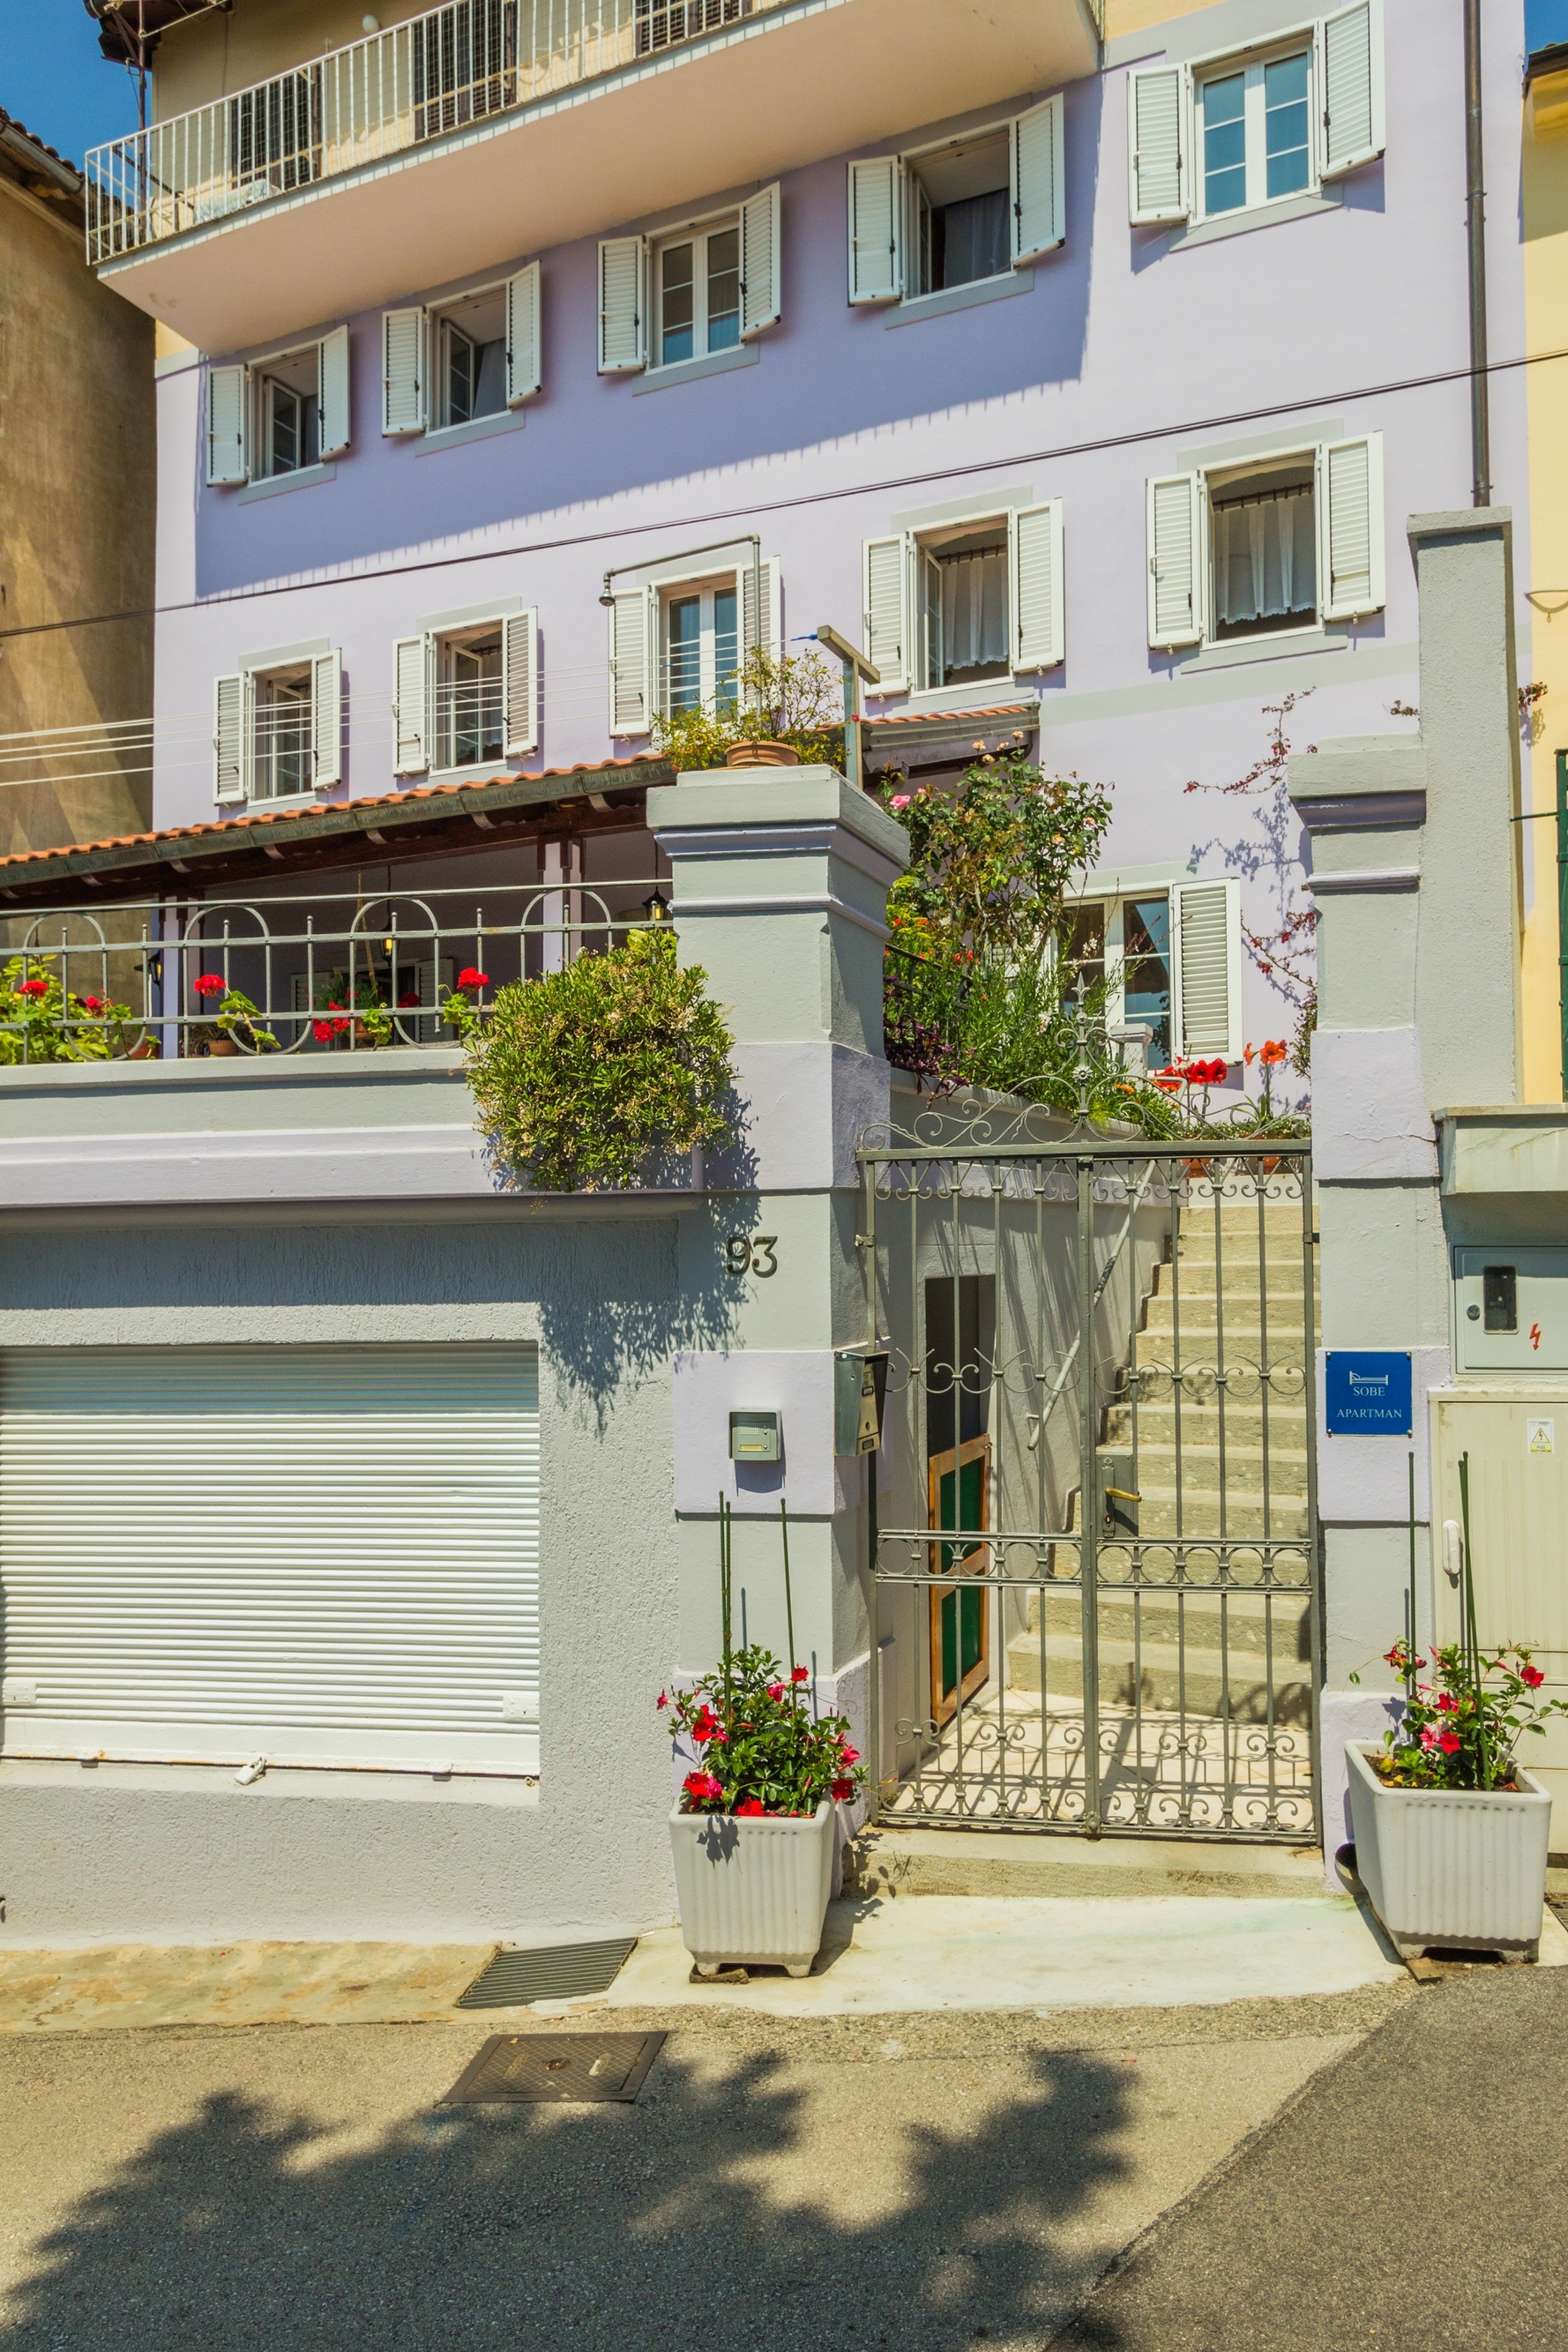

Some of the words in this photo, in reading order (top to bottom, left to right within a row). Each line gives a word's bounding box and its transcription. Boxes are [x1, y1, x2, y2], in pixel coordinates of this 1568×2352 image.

[726, 1236, 778, 1279] 93
[1353, 1386, 1385, 1397] SOBE
[1336, 1408, 1402, 1418] APARTMAN
